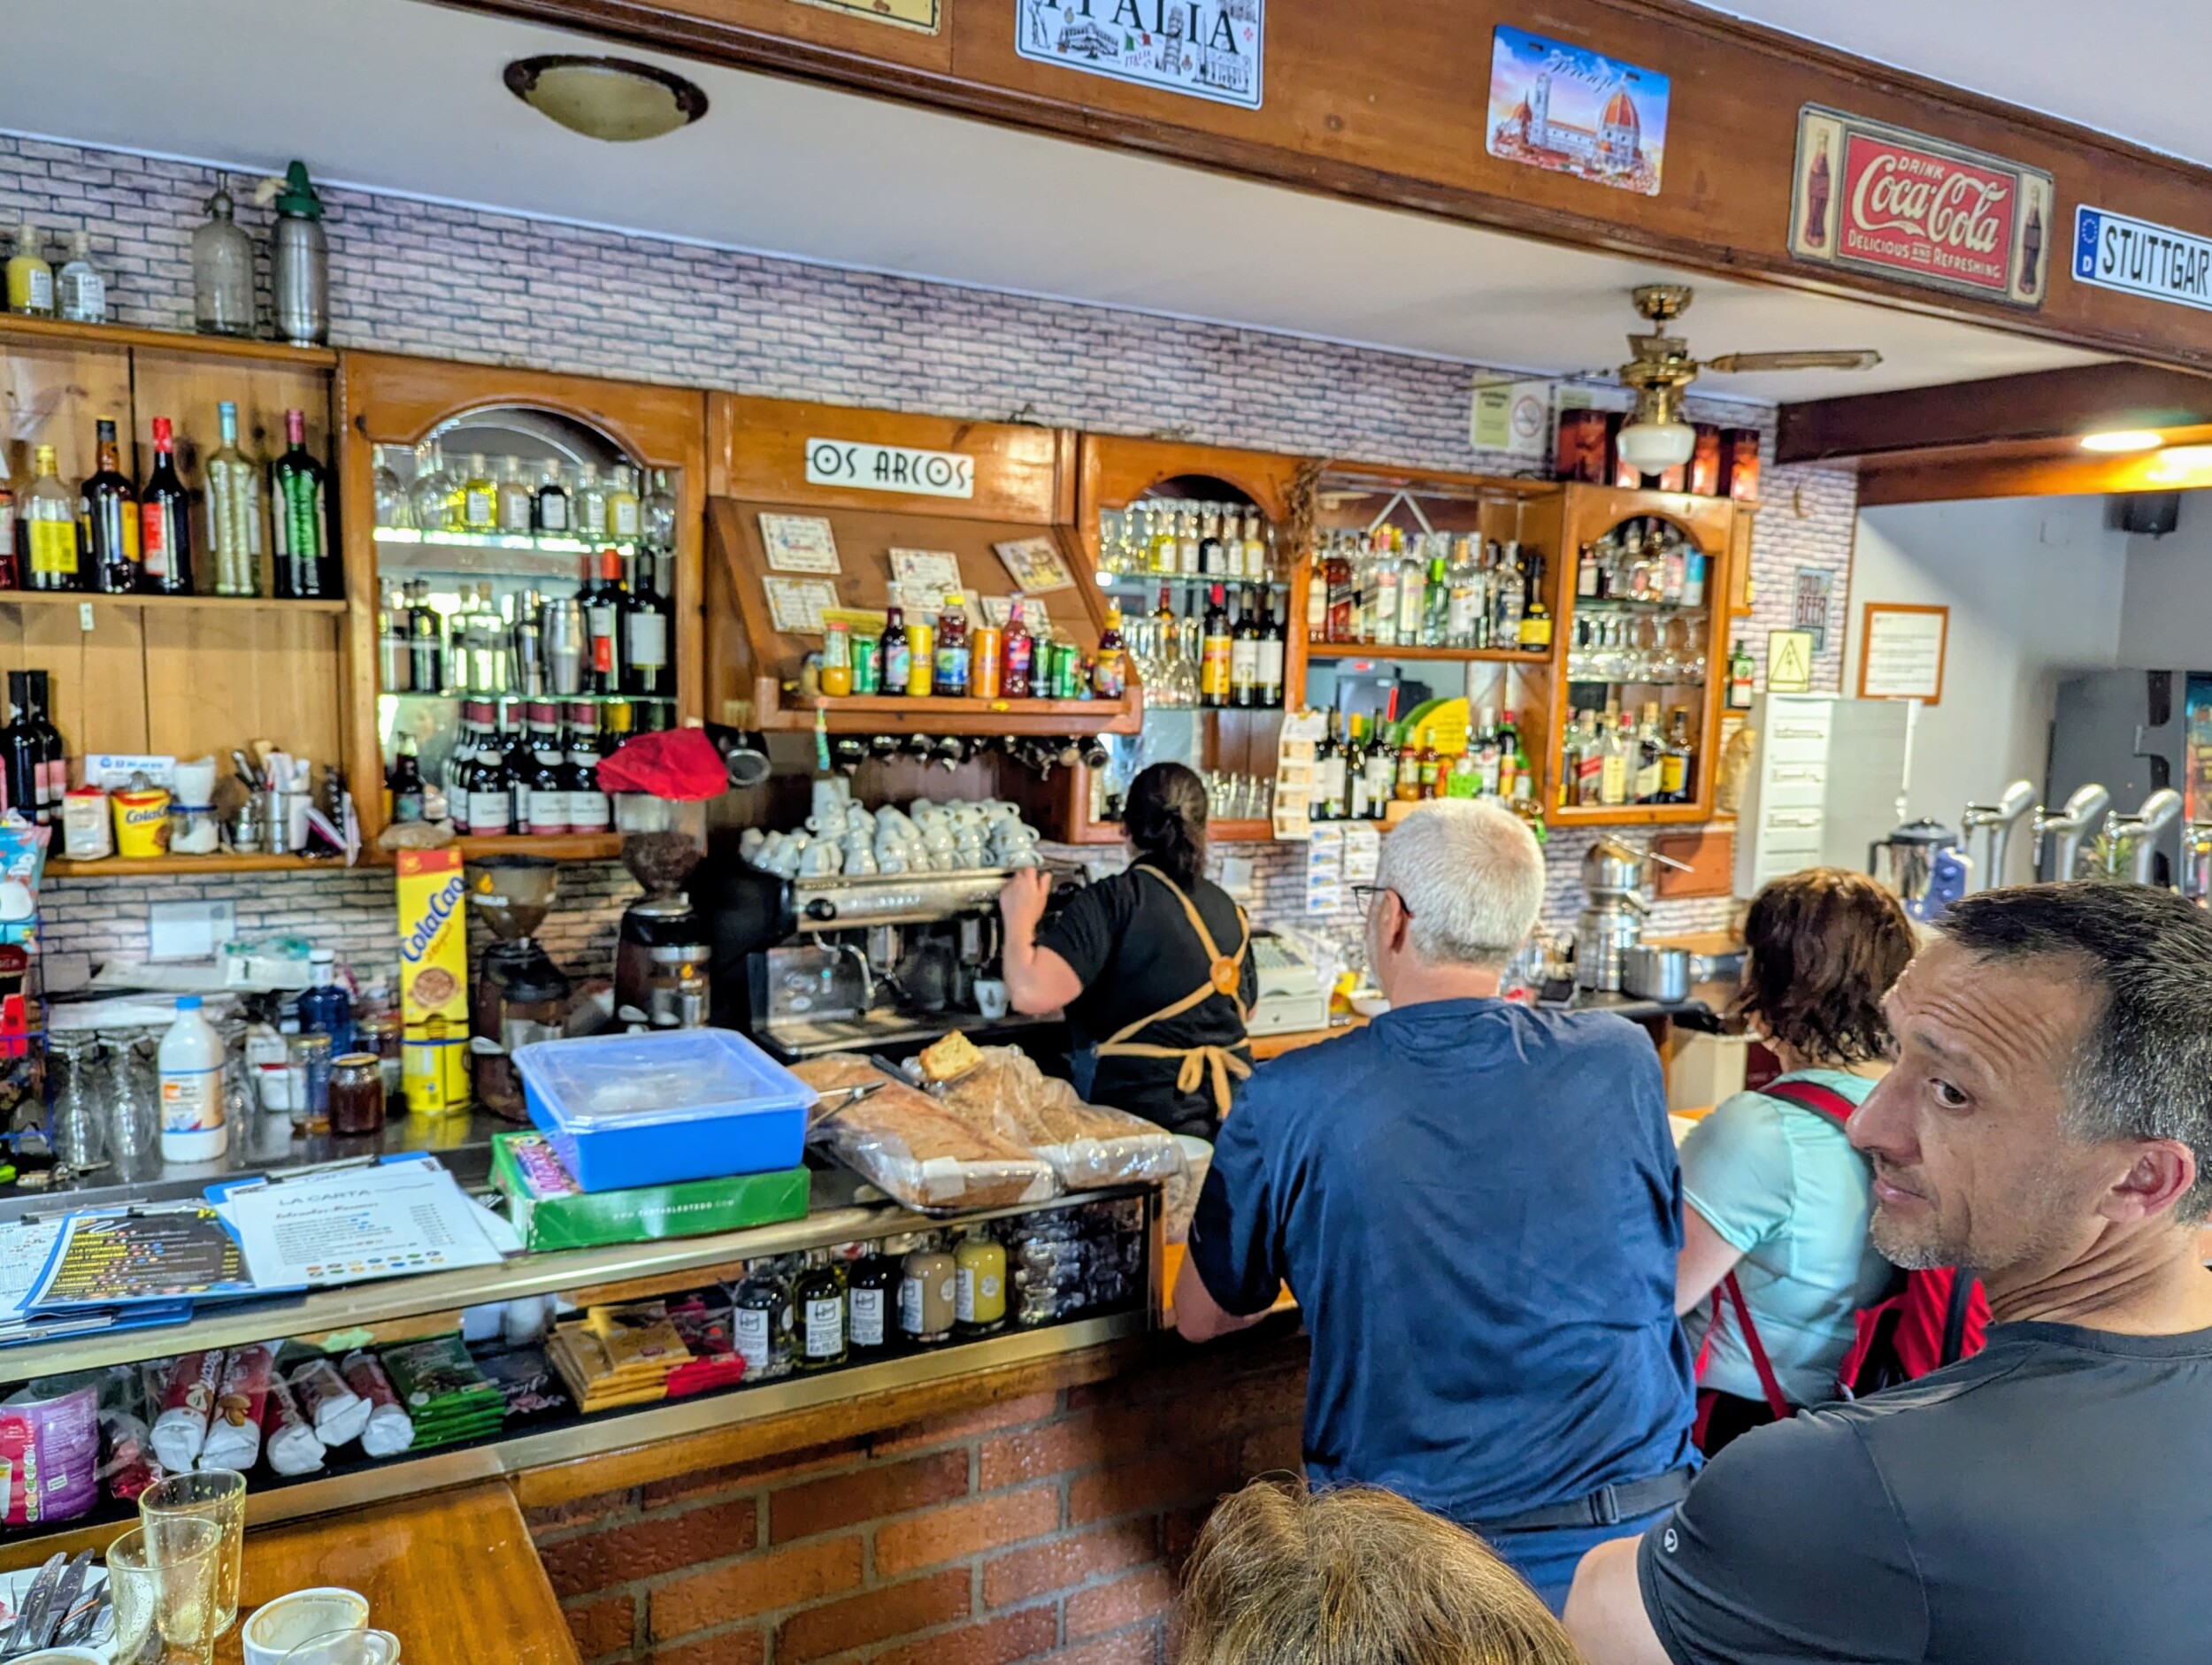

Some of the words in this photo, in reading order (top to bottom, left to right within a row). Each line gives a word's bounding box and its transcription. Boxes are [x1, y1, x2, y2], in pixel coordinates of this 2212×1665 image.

[1045, 0, 1239, 54] ALIA
[1898, 156, 1945, 180] DRINK
[1848, 229, 1909, 258] DELICIOUS
[1933, 248, 2001, 279] REFRESHING
[2082, 255, 2093, 272] D
[2102, 225, 2212, 297] STUTTGAR
[813, 444, 857, 478] OS
[873, 451, 967, 489] ARCOS
[401, 876, 466, 963] ColaCao
[279, 1197, 303, 1206] LA
[307, 1190, 371, 1203] CARTA
